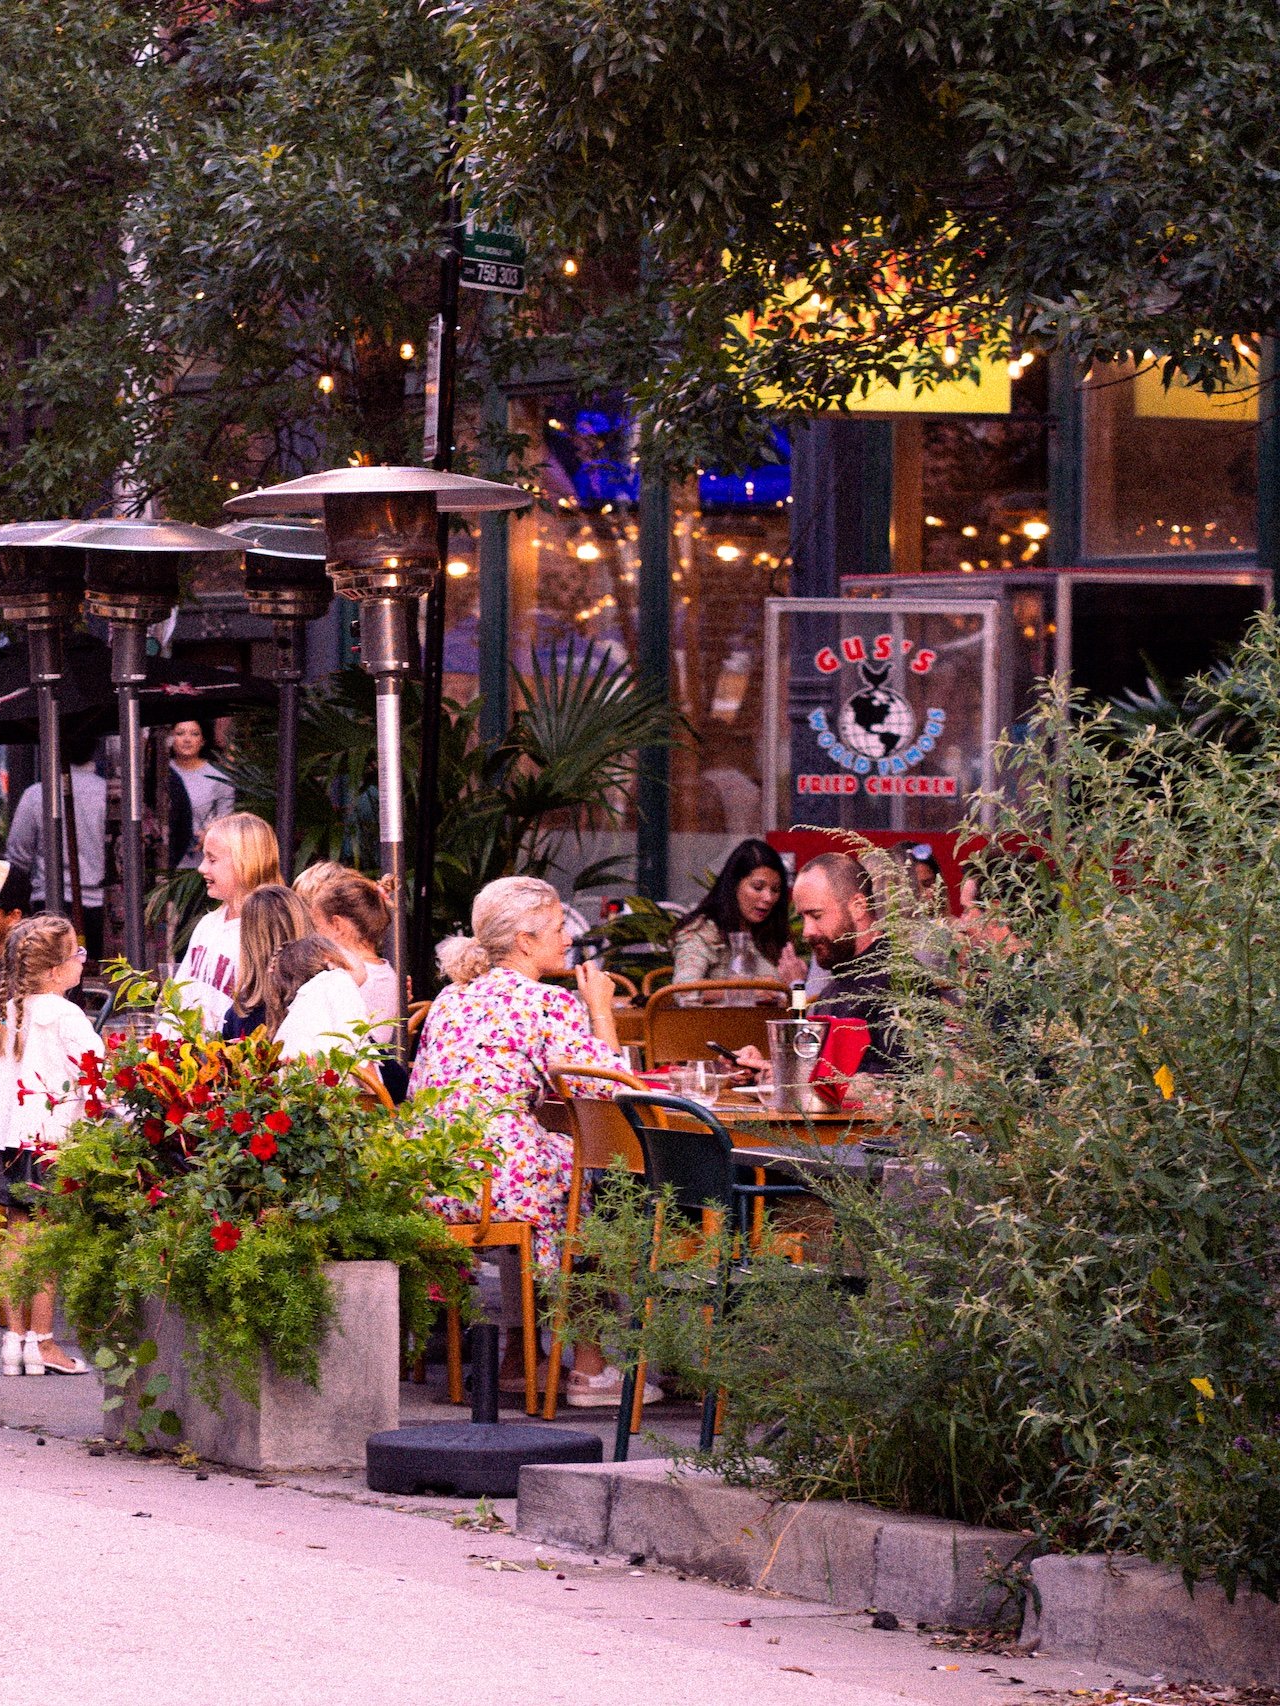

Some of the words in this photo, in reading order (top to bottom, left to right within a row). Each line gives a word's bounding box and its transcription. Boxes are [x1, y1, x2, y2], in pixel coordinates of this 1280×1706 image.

[477, 264, 497, 283] 759
[499, 267, 518, 285] 303
[815, 634, 936, 673] GUS'S
[808, 708, 870, 773] WORLD
[878, 708, 946, 775] FAMOUS
[797, 774, 859, 795] FRIED
[865, 775, 957, 796] CHICKEN
